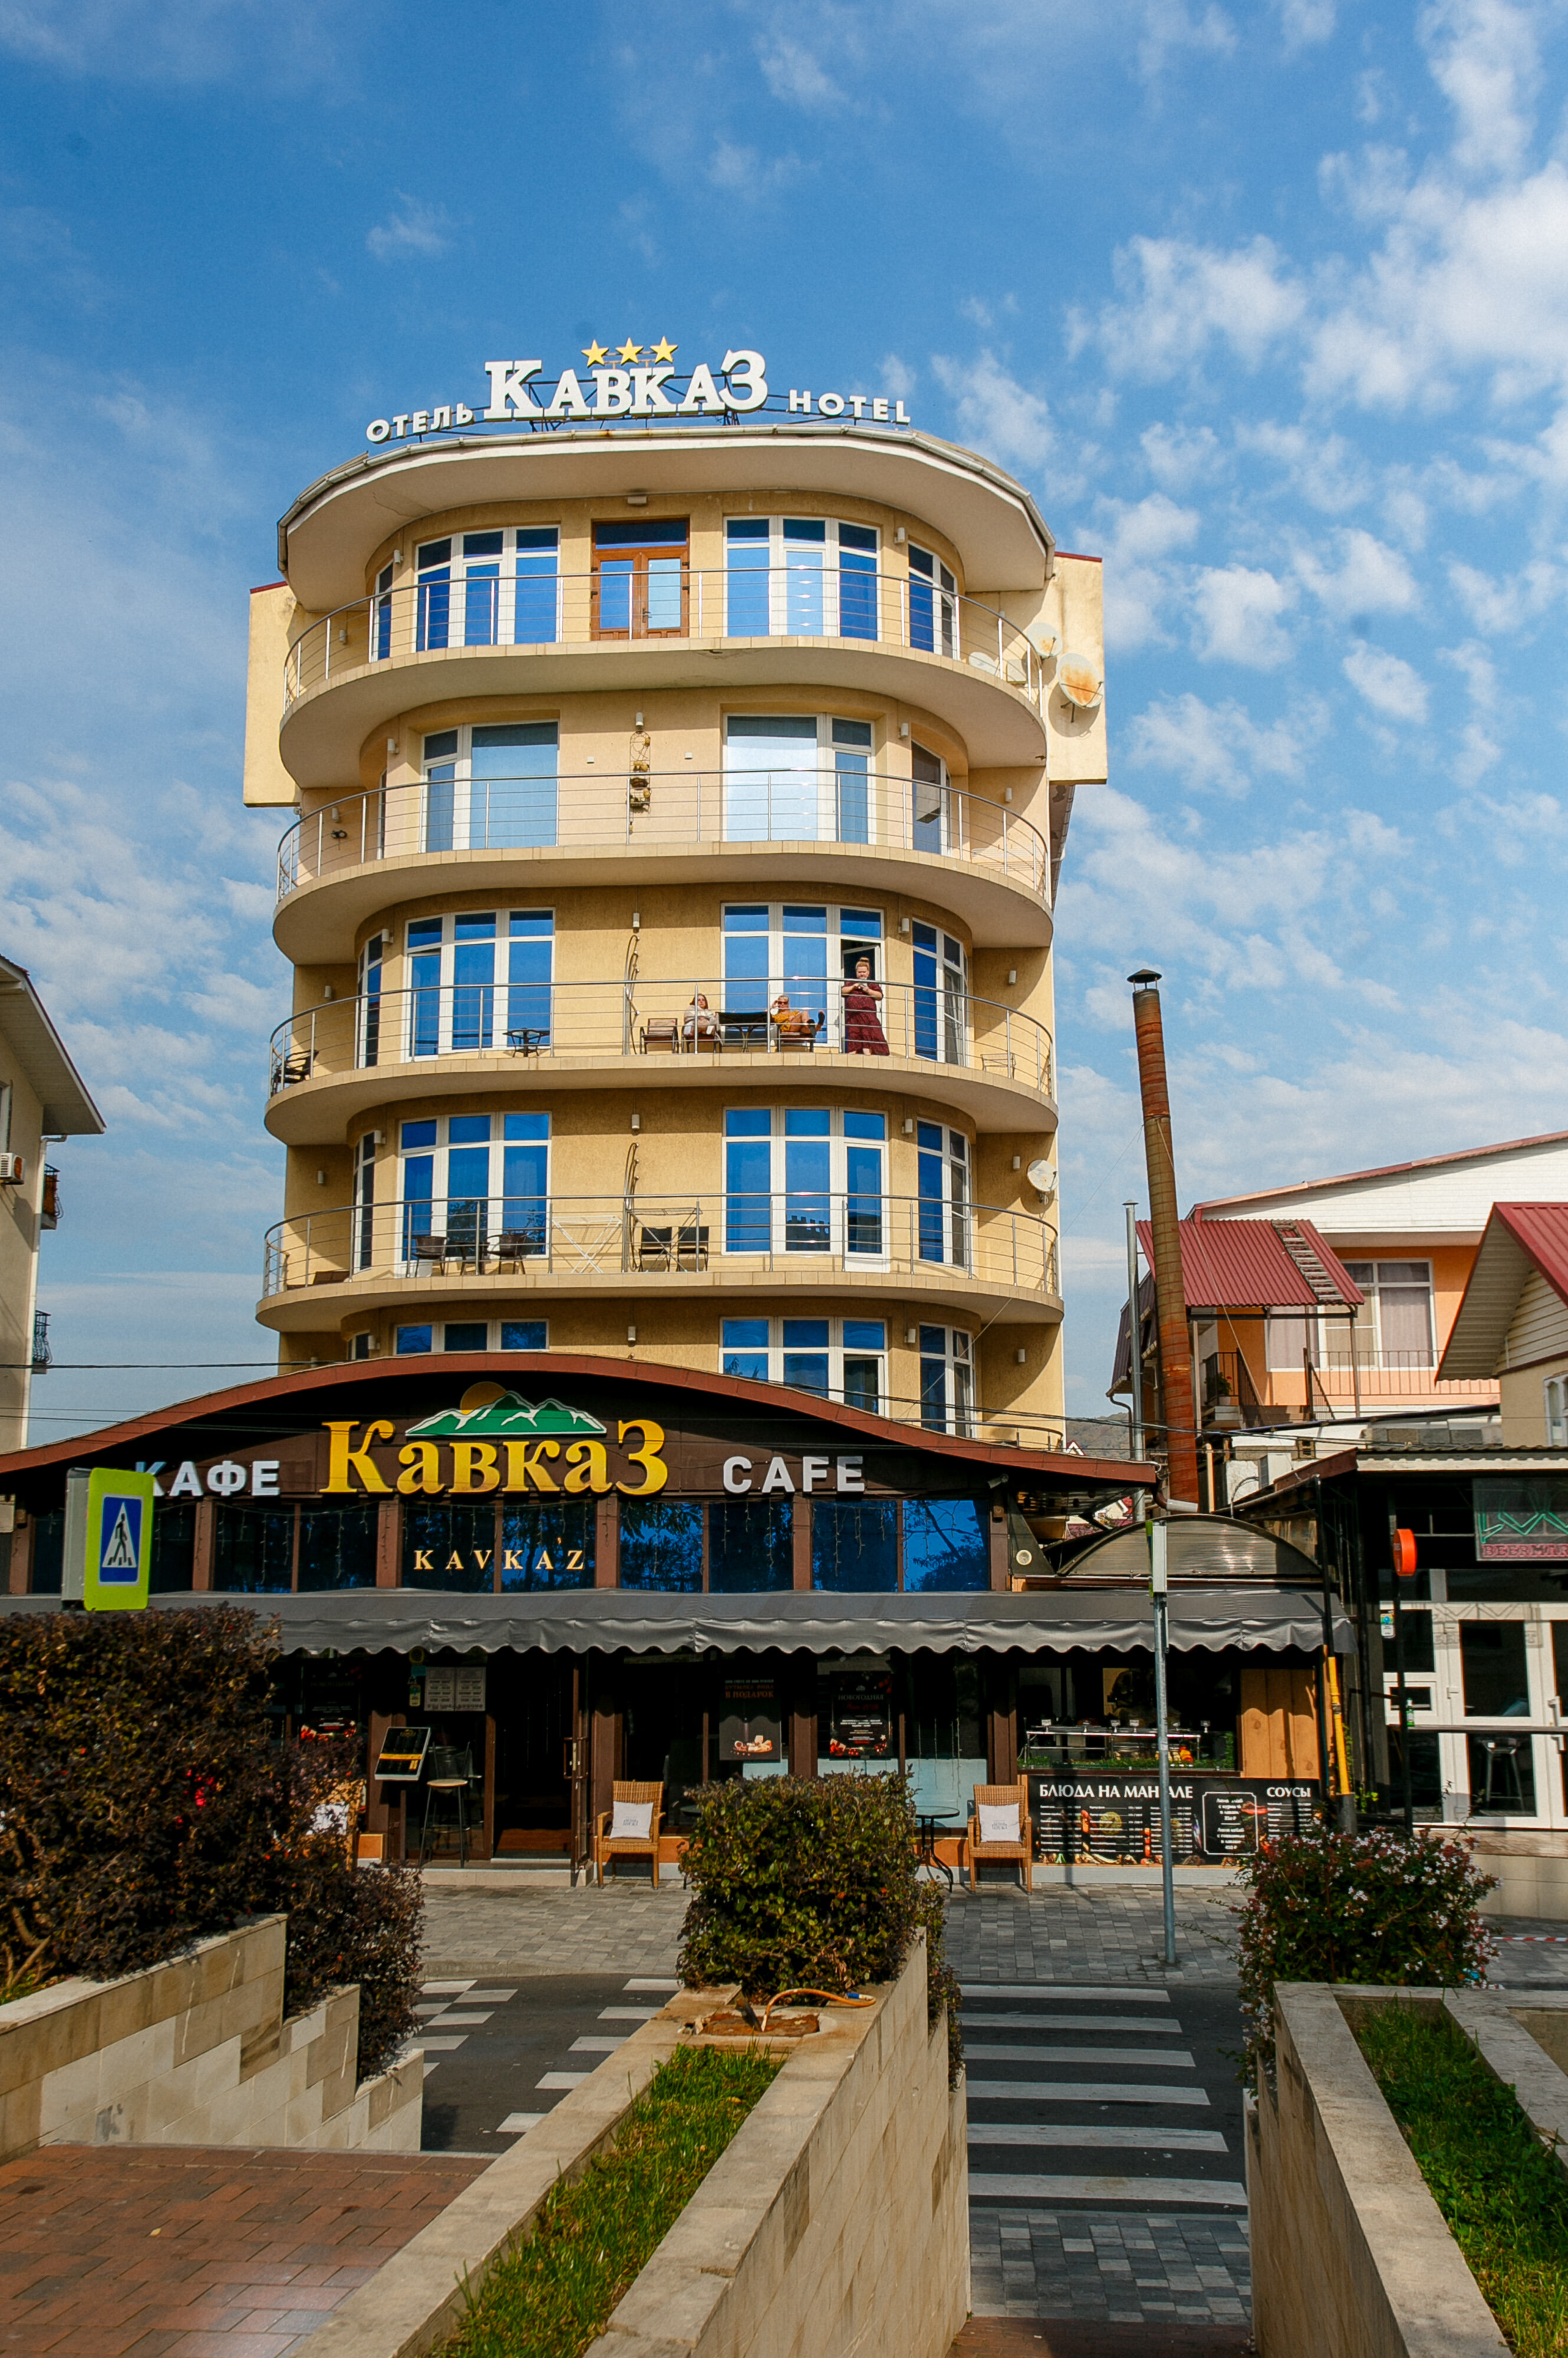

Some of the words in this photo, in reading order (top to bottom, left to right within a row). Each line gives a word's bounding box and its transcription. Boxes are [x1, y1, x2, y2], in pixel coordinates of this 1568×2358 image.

[366, 403, 475, 444] ОТЕЛЬ
[484, 349, 768, 421] КАВКАЗ
[789, 389, 911, 424] HOTEL
[723, 1455, 866, 1494] CAFE
[1039, 1784, 1095, 1797] БЛЮДА
[1098, 1785, 1121, 1797] НА
[1124, 1786, 1193, 1799] МАНАЛЕ
[1266, 1787, 1311, 1797] СОУСЫ
